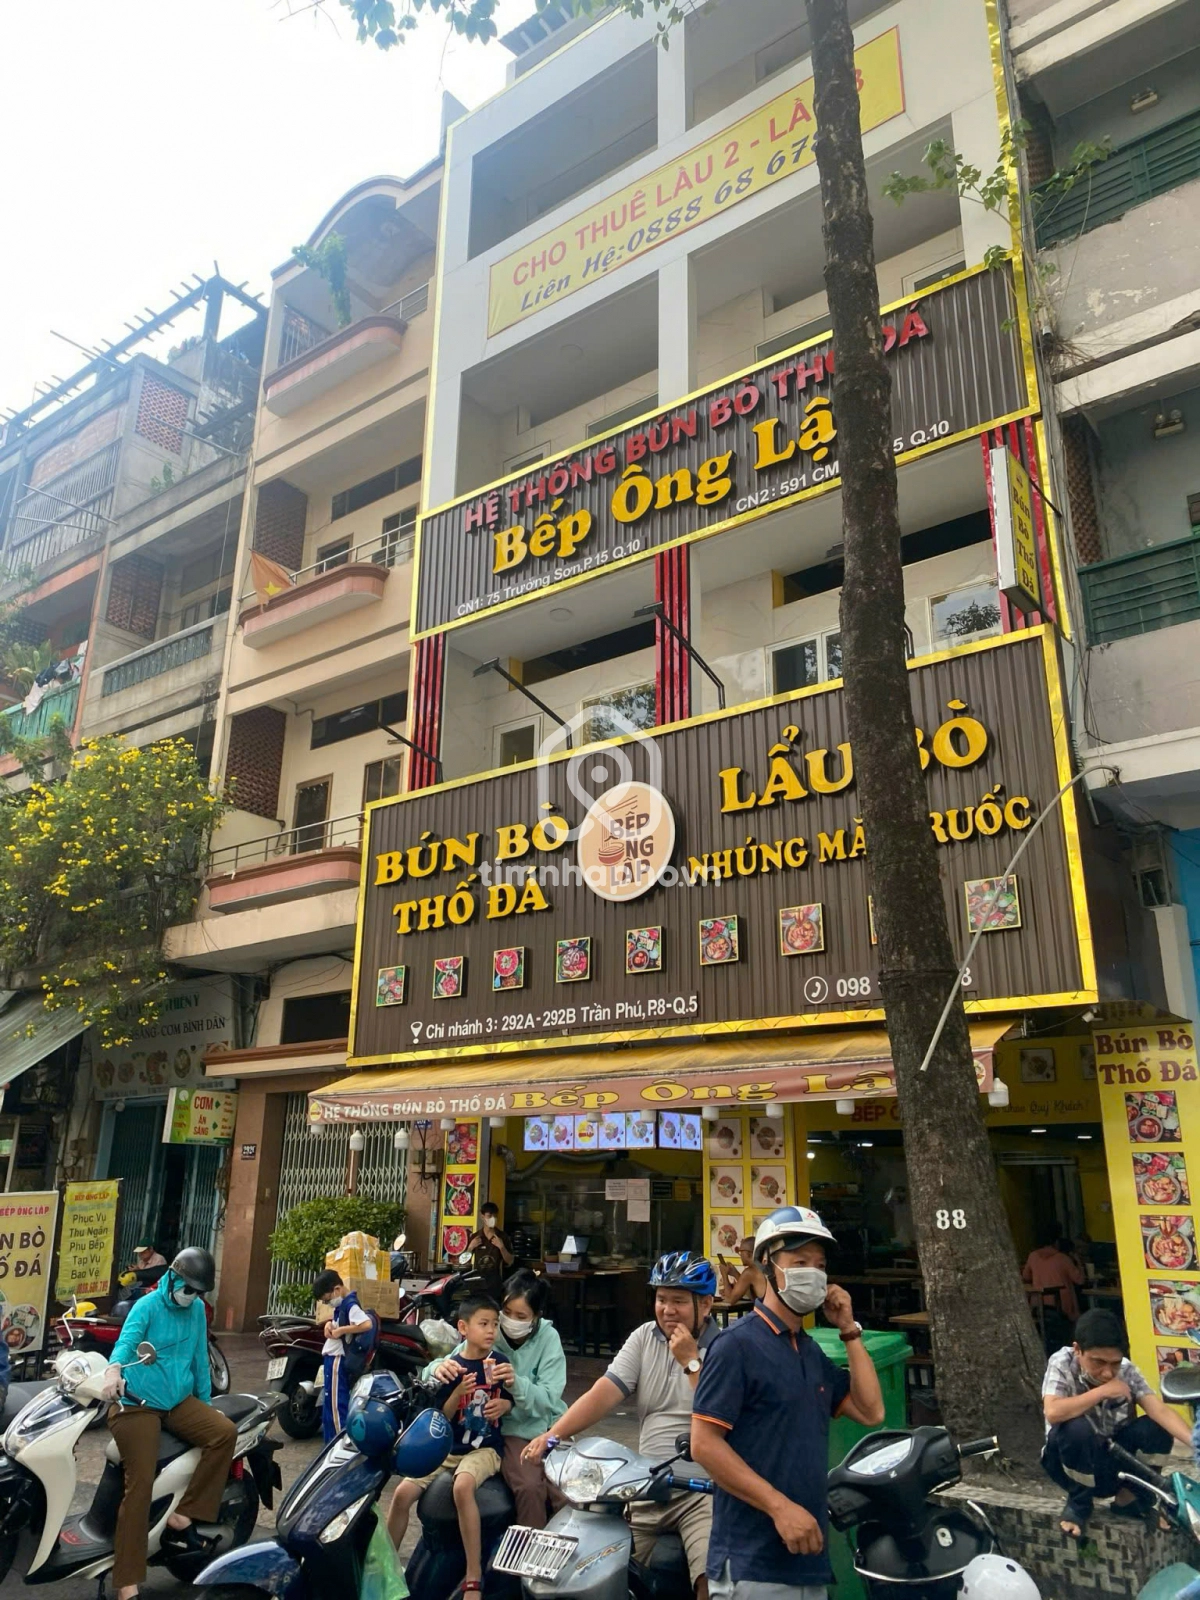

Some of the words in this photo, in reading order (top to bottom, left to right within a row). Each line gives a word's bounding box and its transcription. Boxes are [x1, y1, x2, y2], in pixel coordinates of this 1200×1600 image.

[512, 241, 567, 287] CHO
[574, 190, 647, 251] THUÊ
[723, 140, 740, 168] 2
[769, 97, 811, 144] LẦ
[520, 275, 570, 313] Liên
[714, 166, 754, 205] 68
[893, 436, 904, 453] 5
[910, 420, 950, 444] Q.10
[465, 491, 499, 533] HỆ
[508, 446, 616, 514] THỐNG
[626, 409, 697, 464] BÚN
[711, 378, 760, 428] BÒ
[492, 498, 591, 574] Bếp
[611, 449, 737, 523] Ông
[752, 396, 837, 470] Lậ
[780, 474, 807, 496] 591
[811, 460, 840, 483] CM
[457, 599, 484, 617] CN1:
[486, 591, 500, 606] 75
[503, 574, 550, 599] Trường
[612, 538, 641, 560] Q.10
[610, 805, 650, 838] BẾP
[374, 831, 480, 886] BÚN
[495, 802, 570, 861] BÒ
[688, 836, 808, 884] NHÚNG
[393, 873, 478, 935] THỐ
[486, 866, 549, 919] ĐÁ
[836, 976, 872, 997] 098
[425, 1024, 444, 1040] Chi
[448, 1020, 483, 1037] nhánh
[581, 1002, 611, 1023] Trần
[1095, 1033, 1150, 1055] Bún
[1156, 1028, 1193, 1051] Bò
[1099, 1057, 1151, 1084] Thố
[1160, 1058, 1197, 1082] Đá
[324, 1104, 340, 1121] HỆ
[344, 1100, 389, 1117] THỐNG
[392, 1098, 422, 1115] BÚN
[426, 1096, 446, 1113] BÒ
[450, 1094, 481, 1112] THỐ
[484, 1093, 507, 1110] ĐÁ
[511, 1085, 620, 1109] Bếp
[640, 1078, 778, 1102] Ông
[802, 1069, 896, 1096] Lậ
[20, 1225, 45, 1248] BÒ
[69, 1228, 84, 1238] Thu
[936, 1209, 967, 1230] 88
[15, 1253, 41, 1277] ĐÁ
